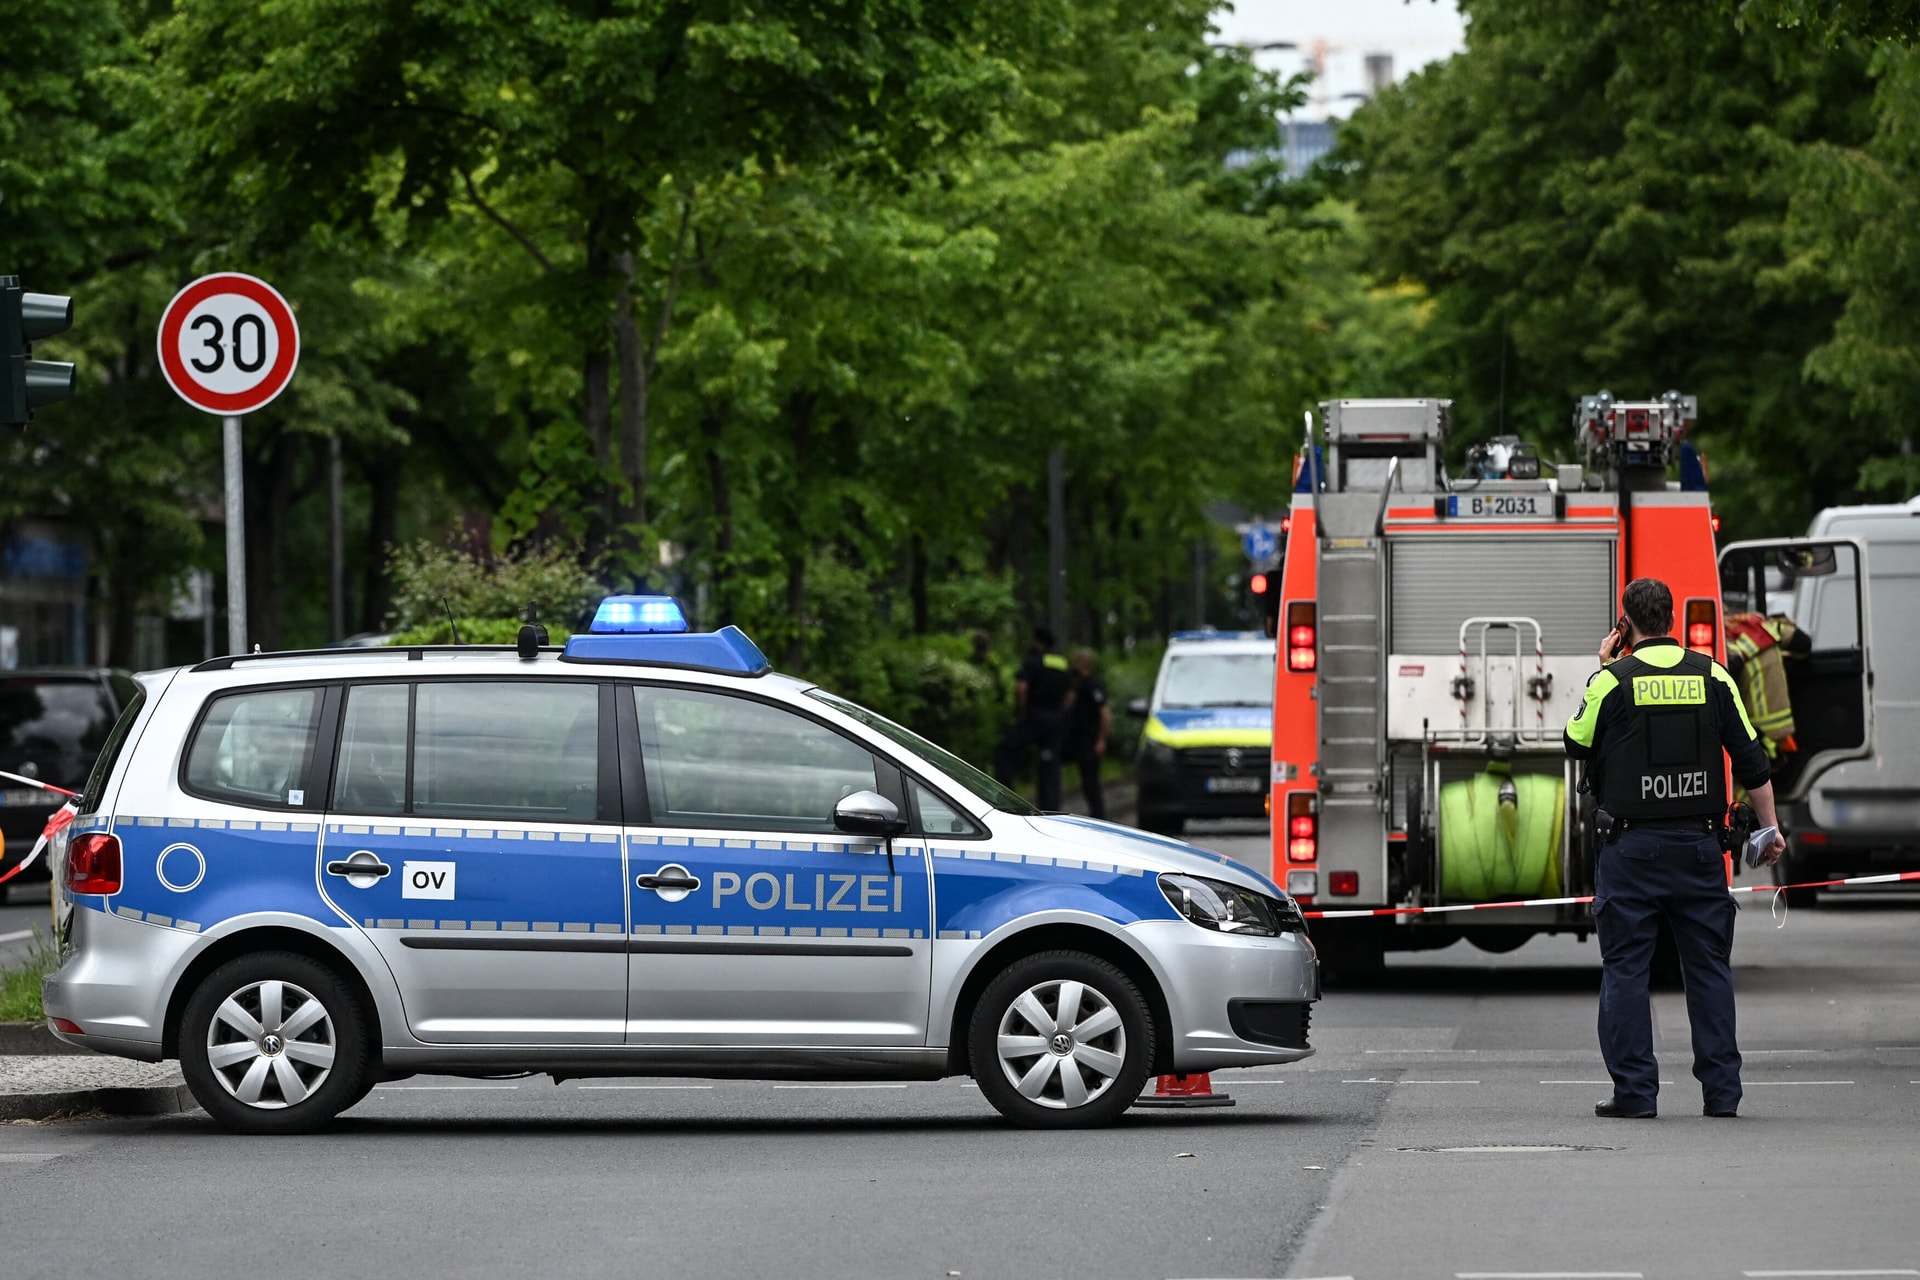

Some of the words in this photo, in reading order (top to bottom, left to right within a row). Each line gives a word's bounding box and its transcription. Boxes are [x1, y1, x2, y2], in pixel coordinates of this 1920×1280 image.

[190, 313, 266, 374] 30
[1472, 498, 1483, 514] B
[1495, 498, 1537, 514] 2031
[1637, 679, 1702, 701] POLIZEI
[1641, 771, 1708, 800] POLIZEI
[412, 871, 446, 889] OV
[712, 871, 903, 913] POLIZEI
